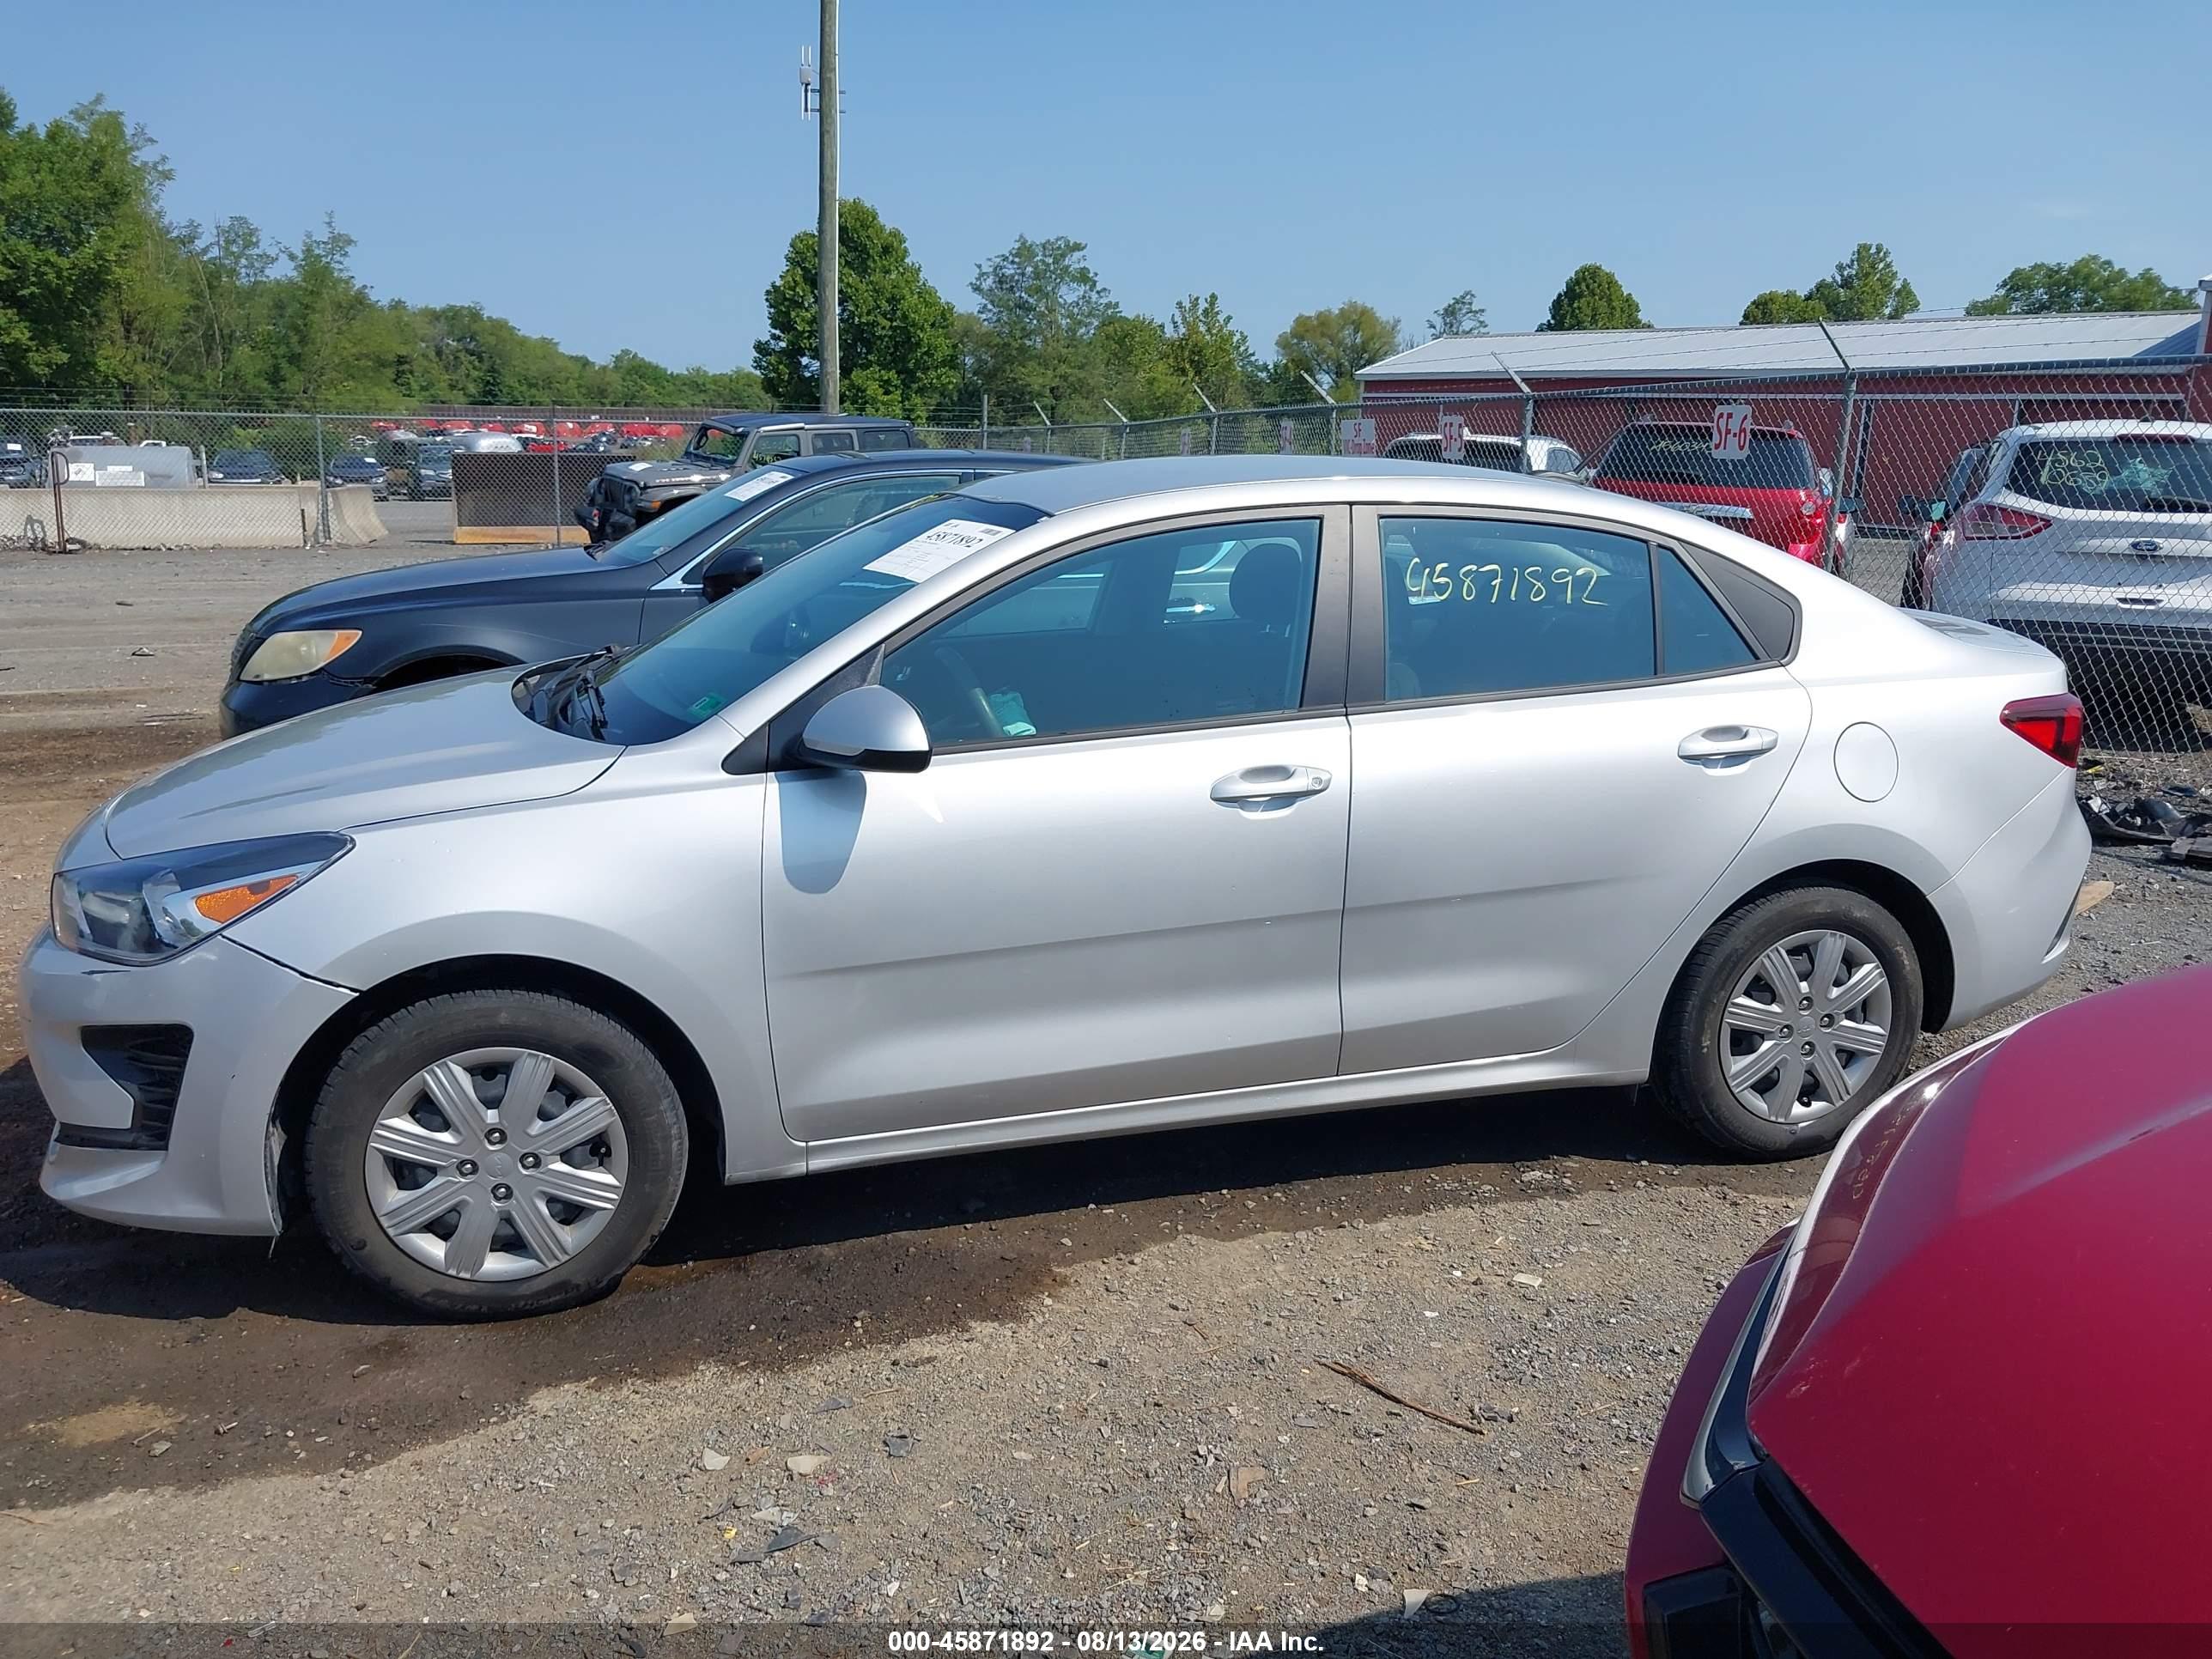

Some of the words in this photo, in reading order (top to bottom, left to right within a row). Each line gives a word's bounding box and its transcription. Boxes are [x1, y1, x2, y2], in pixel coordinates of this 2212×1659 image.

[1353, 422, 1362, 439] SF
[1443, 422, 1463, 453] SF-5
[1714, 412, 1748, 452] SF-6
[926, 530, 984, 548] 45871892
[1407, 557, 1609, 606] 45871892
